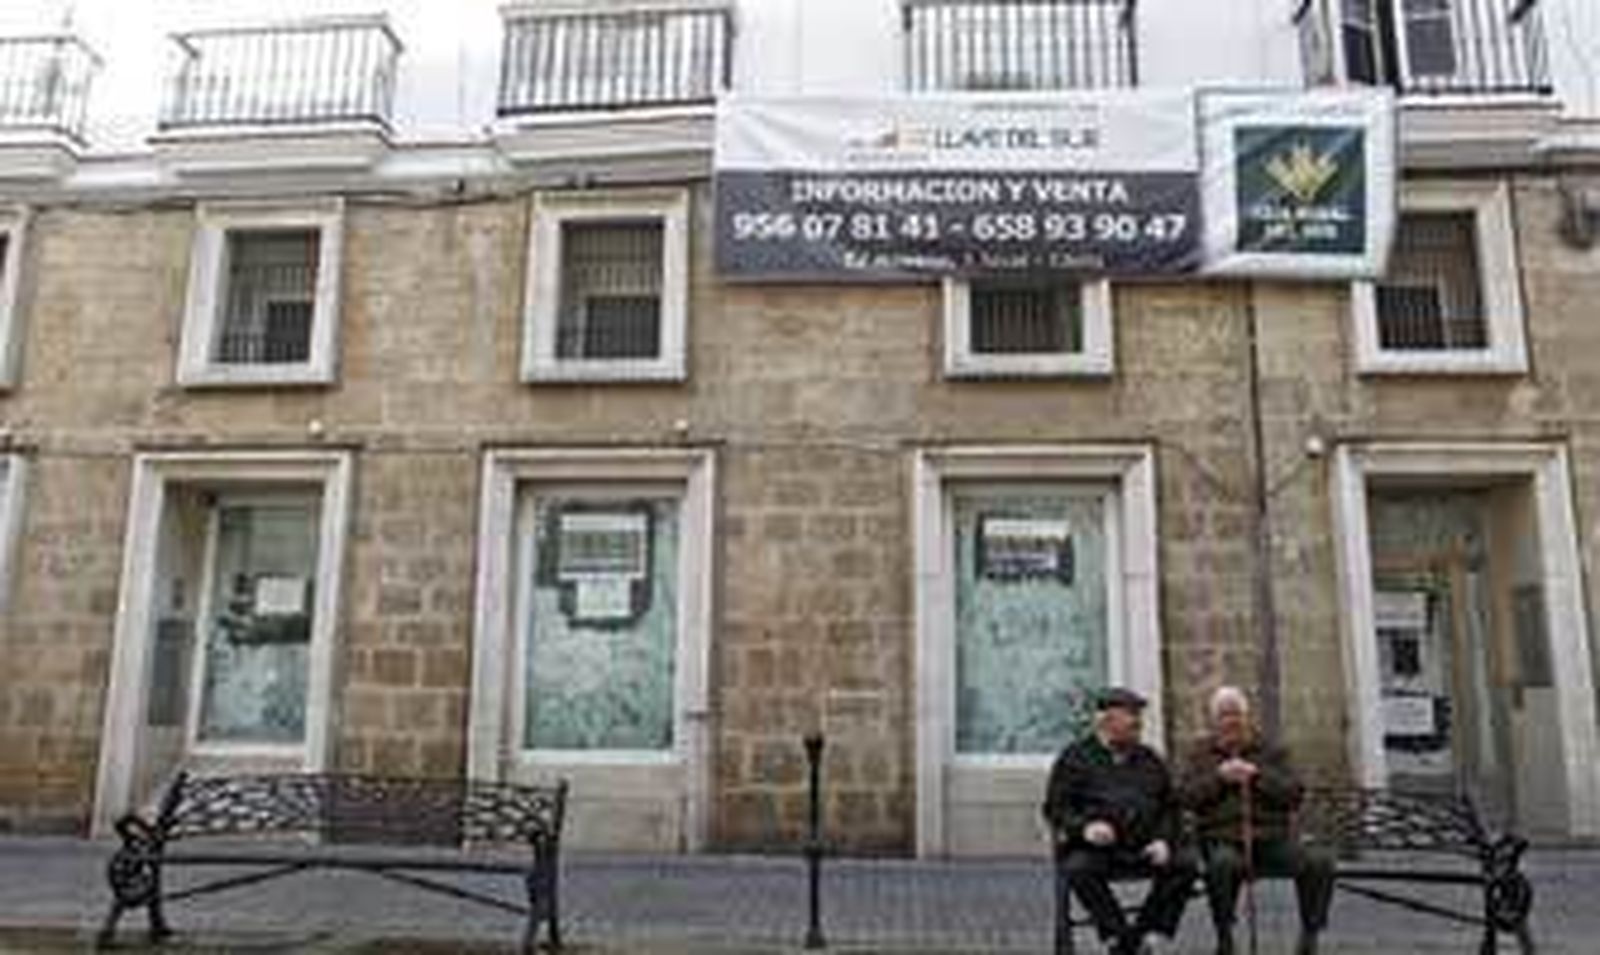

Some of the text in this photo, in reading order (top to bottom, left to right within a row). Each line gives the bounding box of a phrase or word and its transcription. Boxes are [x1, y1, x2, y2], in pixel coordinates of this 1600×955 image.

[1005, 178, 1028, 201] Y
[1031, 178, 1129, 203] VENTA
[732, 212, 798, 241] 956
[802, 213, 844, 241] 07
[851, 213, 891, 240] 81
[899, 213, 941, 241] 41
[972, 213, 1038, 241] 658
[1043, 213, 1087, 241] 93
[1092, 213, 1139, 241] 90
[1144, 213, 1187, 241] 47
